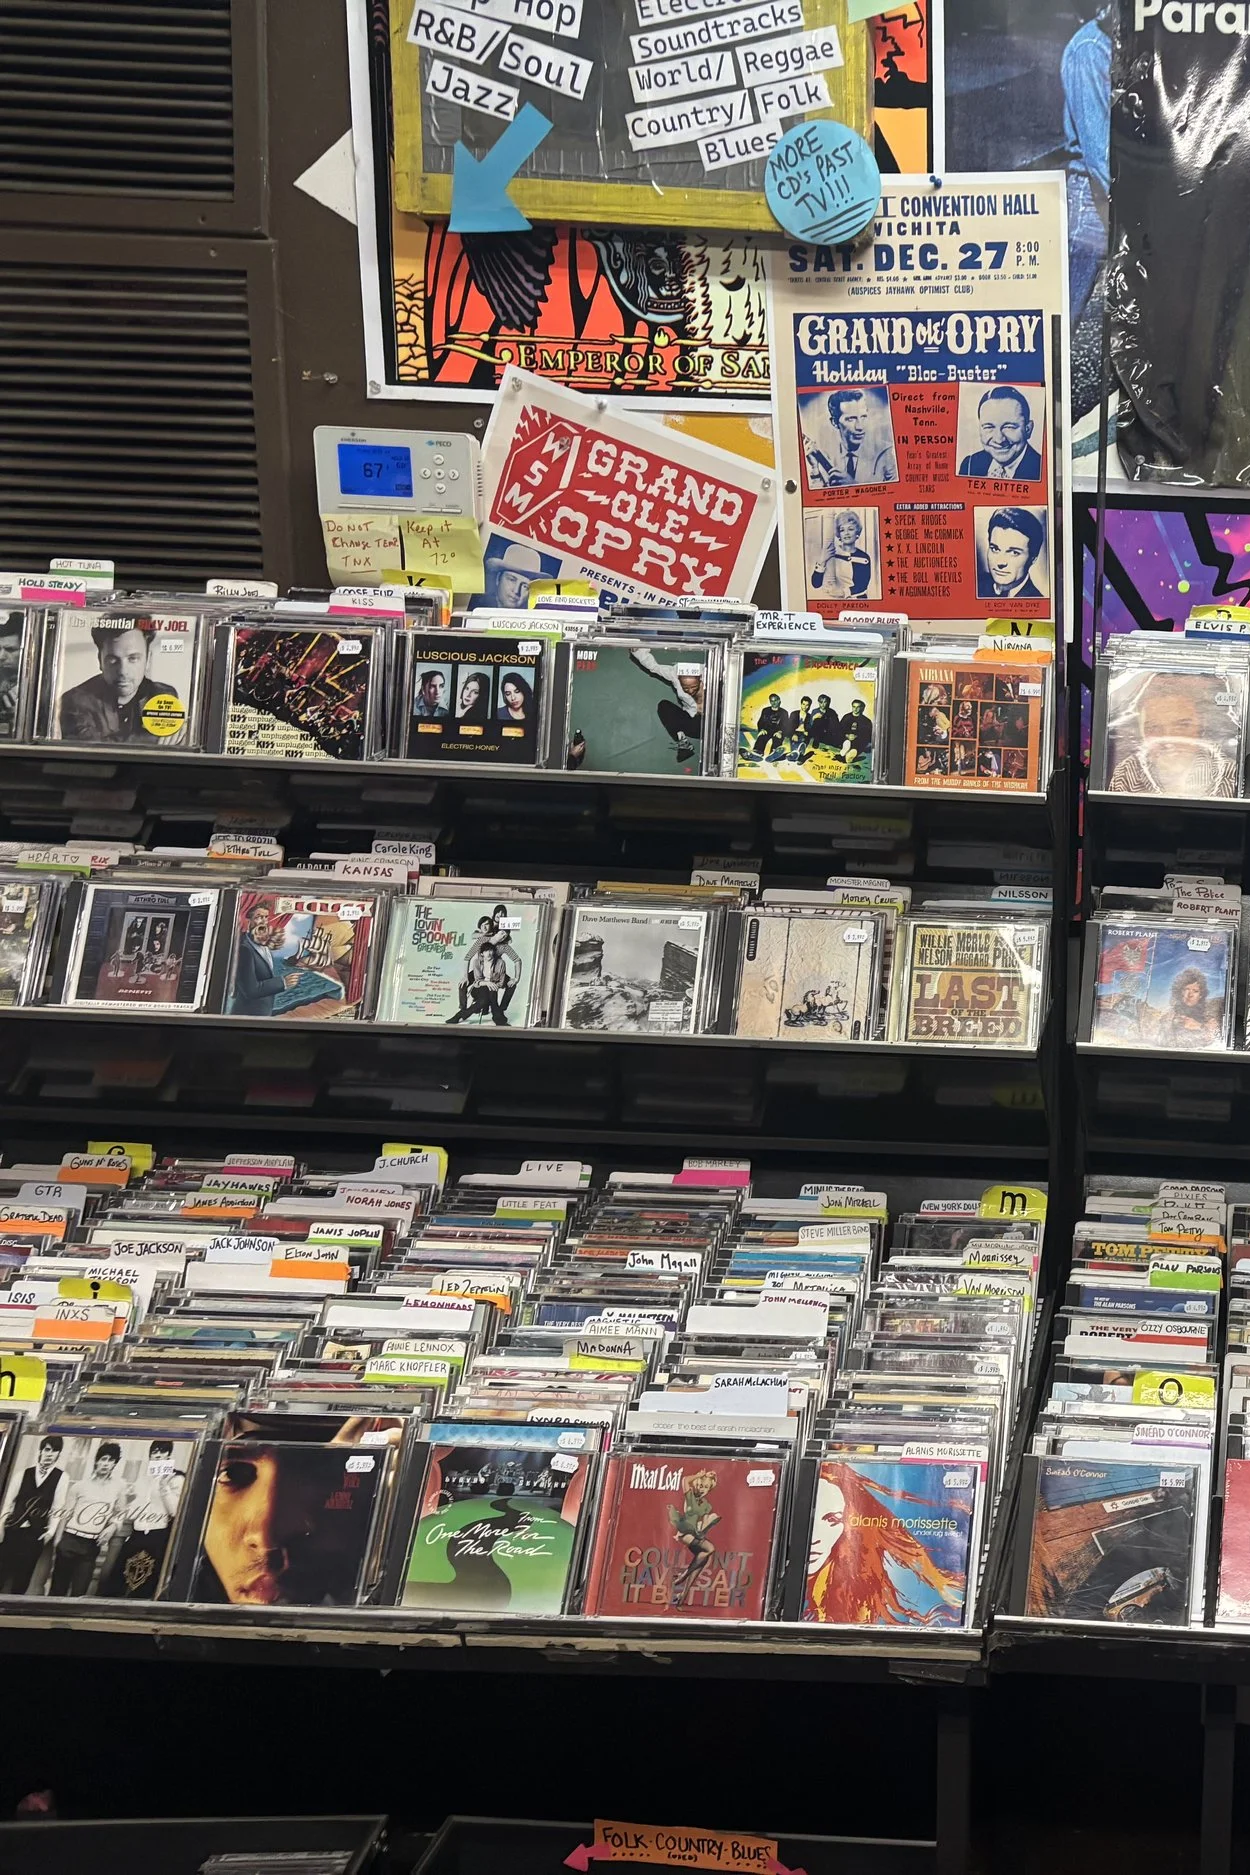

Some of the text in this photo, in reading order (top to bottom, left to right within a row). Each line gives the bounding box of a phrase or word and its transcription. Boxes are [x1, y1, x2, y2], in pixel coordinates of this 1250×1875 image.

[637, 6, 802, 57] Soundtracks
[636, 41, 836, 91] World/ Reggae
[430, 67, 512, 117] Jazz
[630, 85, 823, 139] Country/ Folk
[704, 131, 781, 165] Blues
[770, 128, 823, 177] MORE
[815, 143, 856, 180] PAST
[795, 179, 852, 221] TV!!!
[901, 194, 997, 218] CONVENTION
[1002, 194, 1039, 217] HALL
[788, 241, 1040, 273] SAT. DEC. 27 8:00
[796, 314, 915, 356] GRAND
[944, 312, 1042, 356] OPRY
[518, 344, 667, 377] EMPEROR
[675, 352, 708, 377] OF
[897, 435, 955, 446] IN PERSON
[363, 462, 383, 479] 67
[587, 440, 744, 527] GRAND
[967, 480, 1030, 495] TEX RITTER
[611, 491, 694, 542] OLE
[550, 506, 725, 597] OPRY
[18, 578, 84, 592] HOLD STEADY
[351, 596, 375, 608] KISS
[755, 620, 818, 632] EXPERIENCE
[415, 650, 536, 665] LUSCIOUS JACKSON
[575, 649, 599, 661] MOBY
[918, 667, 954, 683] NIRVANA
[373, 842, 433, 860] Carole King
[342, 864, 394, 878] KANSAS
[997, 888, 1049, 900] NILSSON
[414, 904, 434, 919] THE
[1176, 901, 1241, 918] ROBERT PLANT
[411, 930, 467, 948] SPOONFUL
[919, 933, 990, 952] WILLIE MERLE
[912, 973, 1026, 1012] LAST
[525, 1162, 564, 1174] LIVE
[205, 1179, 270, 1193] JAYHAWKS
[346, 1194, 412, 1212] NORAH JONES
[312, 1226, 381, 1239] JANIS JOPLIN
[113, 1242, 183, 1256] JOE JACKSON
[209, 1237, 276, 1253] JACK JOHNSON
[7, 1291, 36, 1304] ISIS
[404, 1298, 473, 1312] LEMONHEADS
[55, 1308, 90, 1321] INXS
[1140, 1322, 1206, 1335] OZZY OSBOURNE
[369, 1359, 448, 1375] MARC KNOPFLER
[905, 1446, 982, 1458] ALANIS MORISSETTE
[629, 1463, 684, 1491] Meat Loaf
[849, 1514, 958, 1530] alanis morissette
[425, 1522, 556, 1546] One More For
[454, 1540, 555, 1558] The Road
[698, 1567, 753, 1587] SAID
